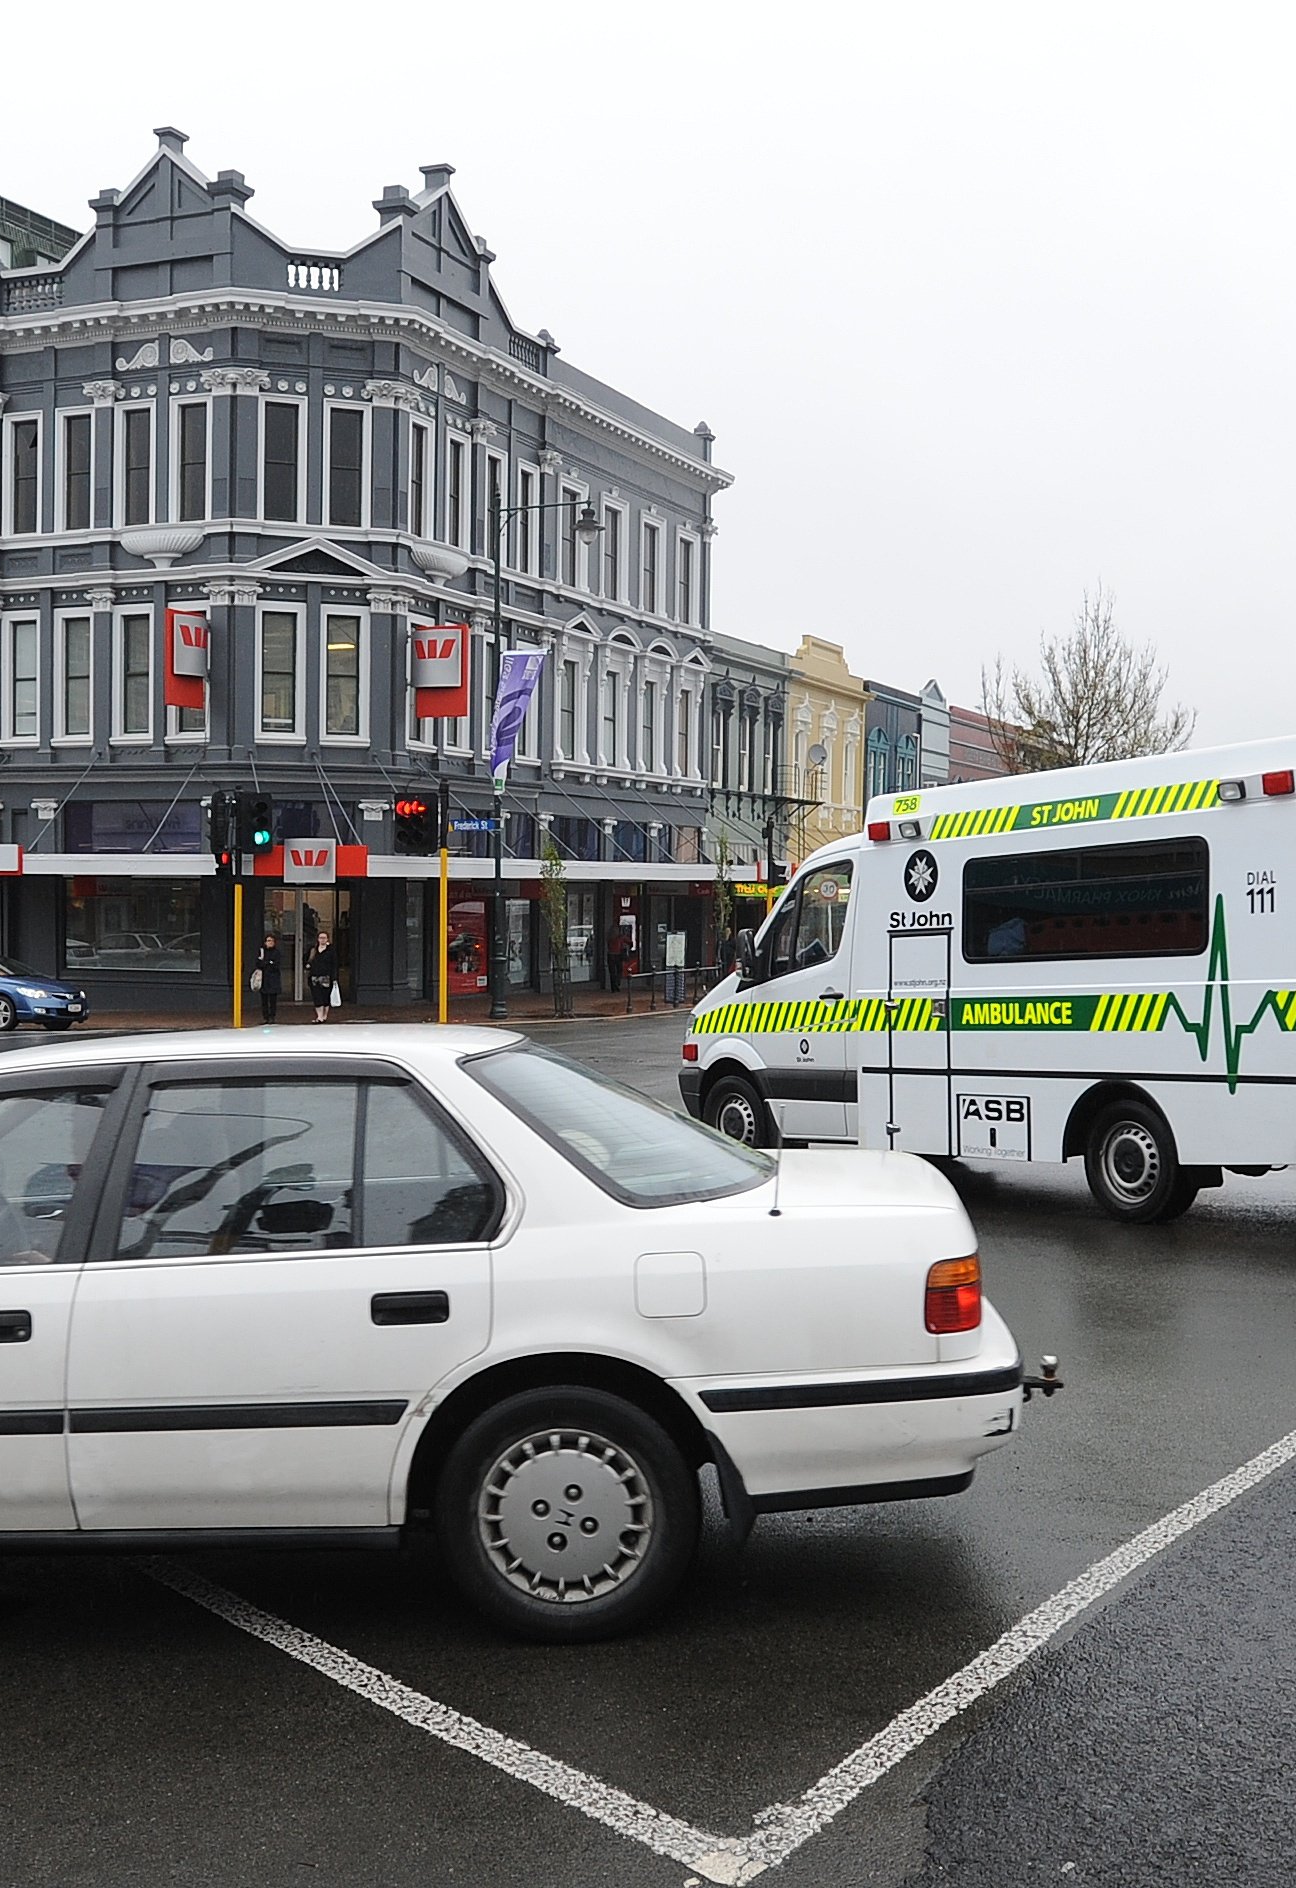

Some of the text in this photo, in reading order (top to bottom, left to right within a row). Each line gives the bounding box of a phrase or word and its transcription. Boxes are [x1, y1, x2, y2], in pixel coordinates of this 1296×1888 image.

[895, 798, 918, 813] 758
[1030, 799, 1100, 826] ST JOHN
[454, 820, 488, 831] Frederick St
[1247, 870, 1277, 885] DIAL
[1246, 887, 1275, 914] 111
[889, 910, 953, 928] St John
[961, 1002, 1073, 1025] AMBULANCE
[962, 1098, 1025, 1123] ASB
